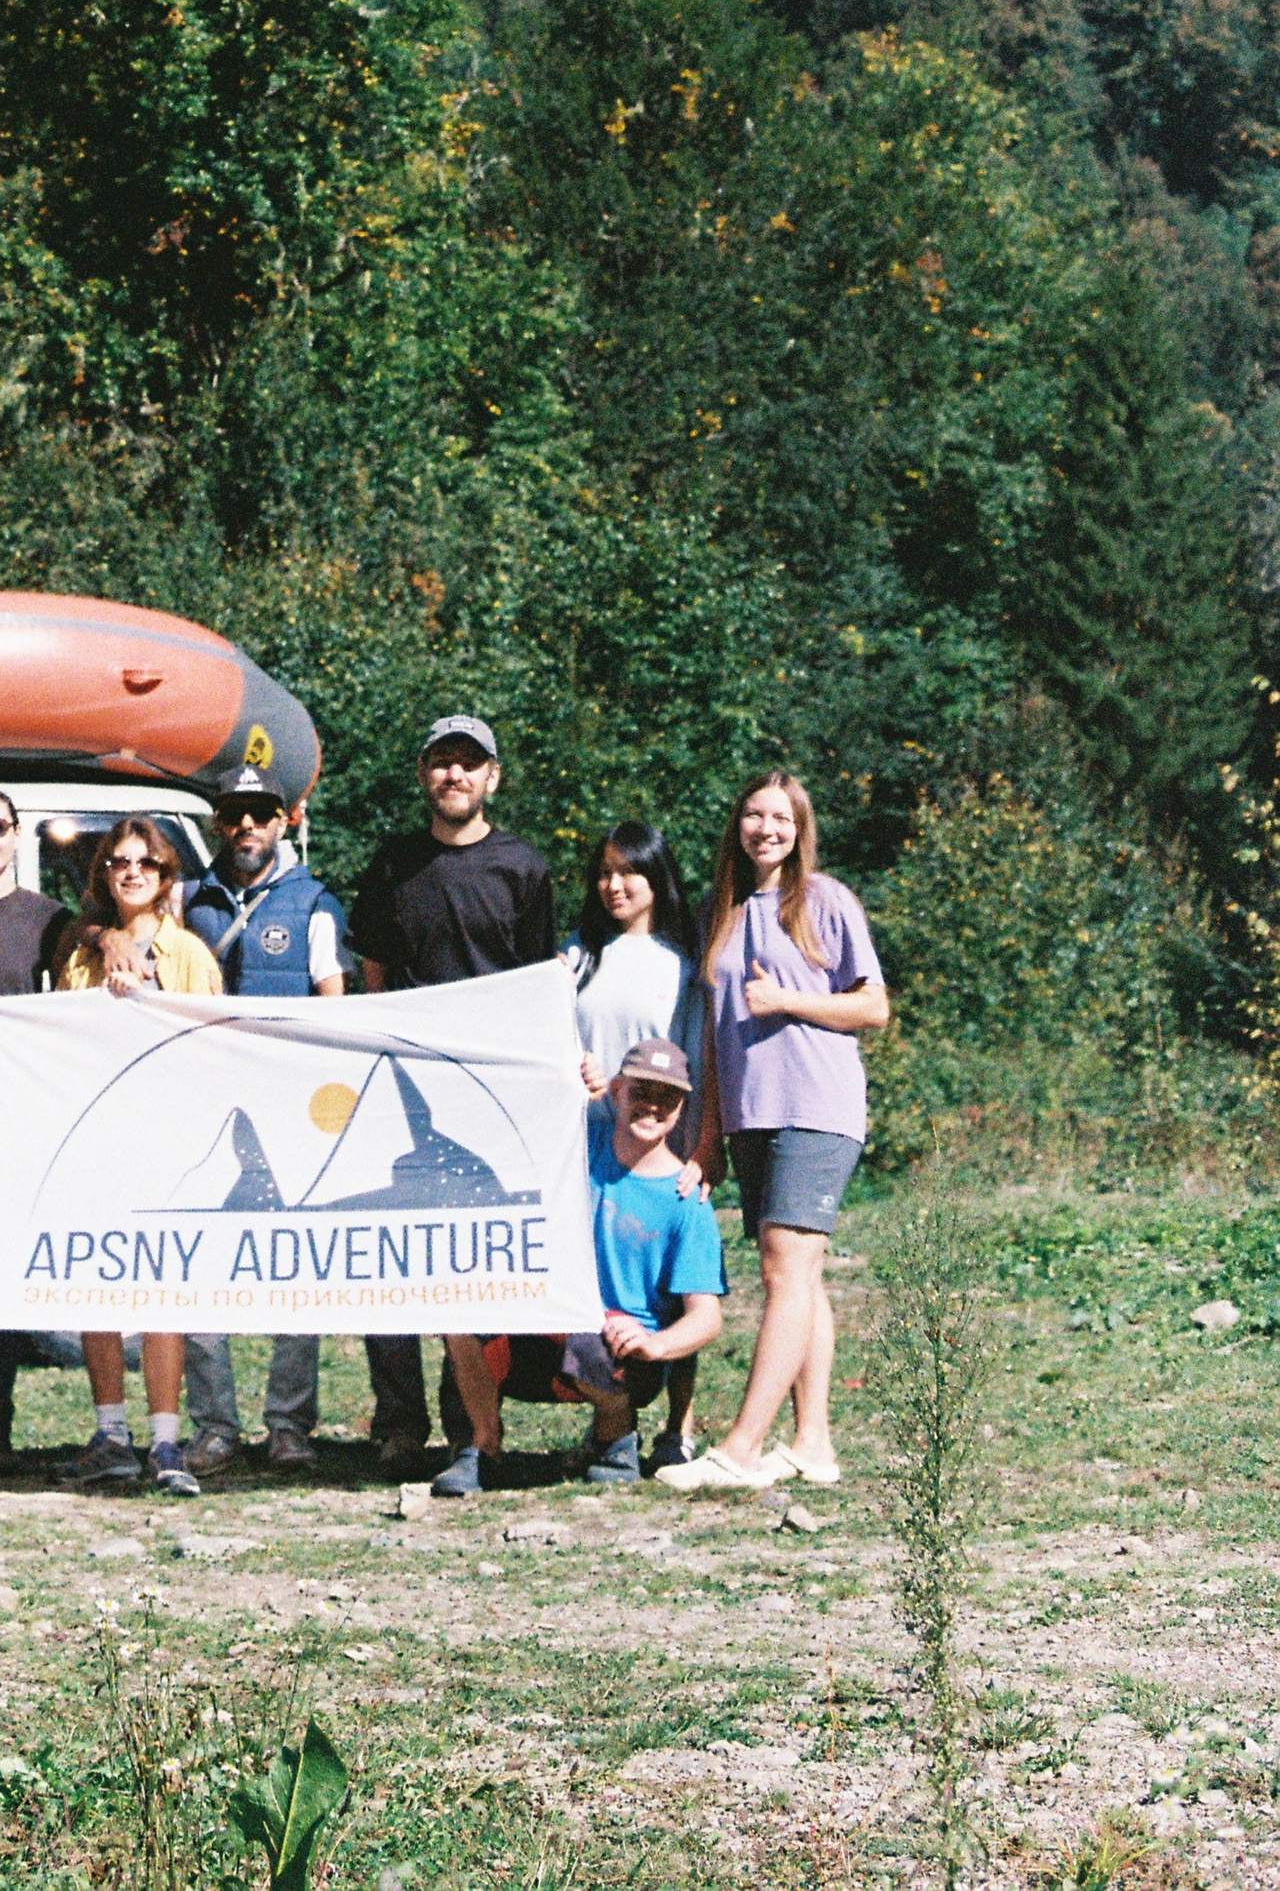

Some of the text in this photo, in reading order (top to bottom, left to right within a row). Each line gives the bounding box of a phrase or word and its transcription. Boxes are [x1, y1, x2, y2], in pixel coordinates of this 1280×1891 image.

[24, 1217, 550, 1281] APSNY ADVENTURE
[23, 1281, 548, 1312] эксперты по приключениям
